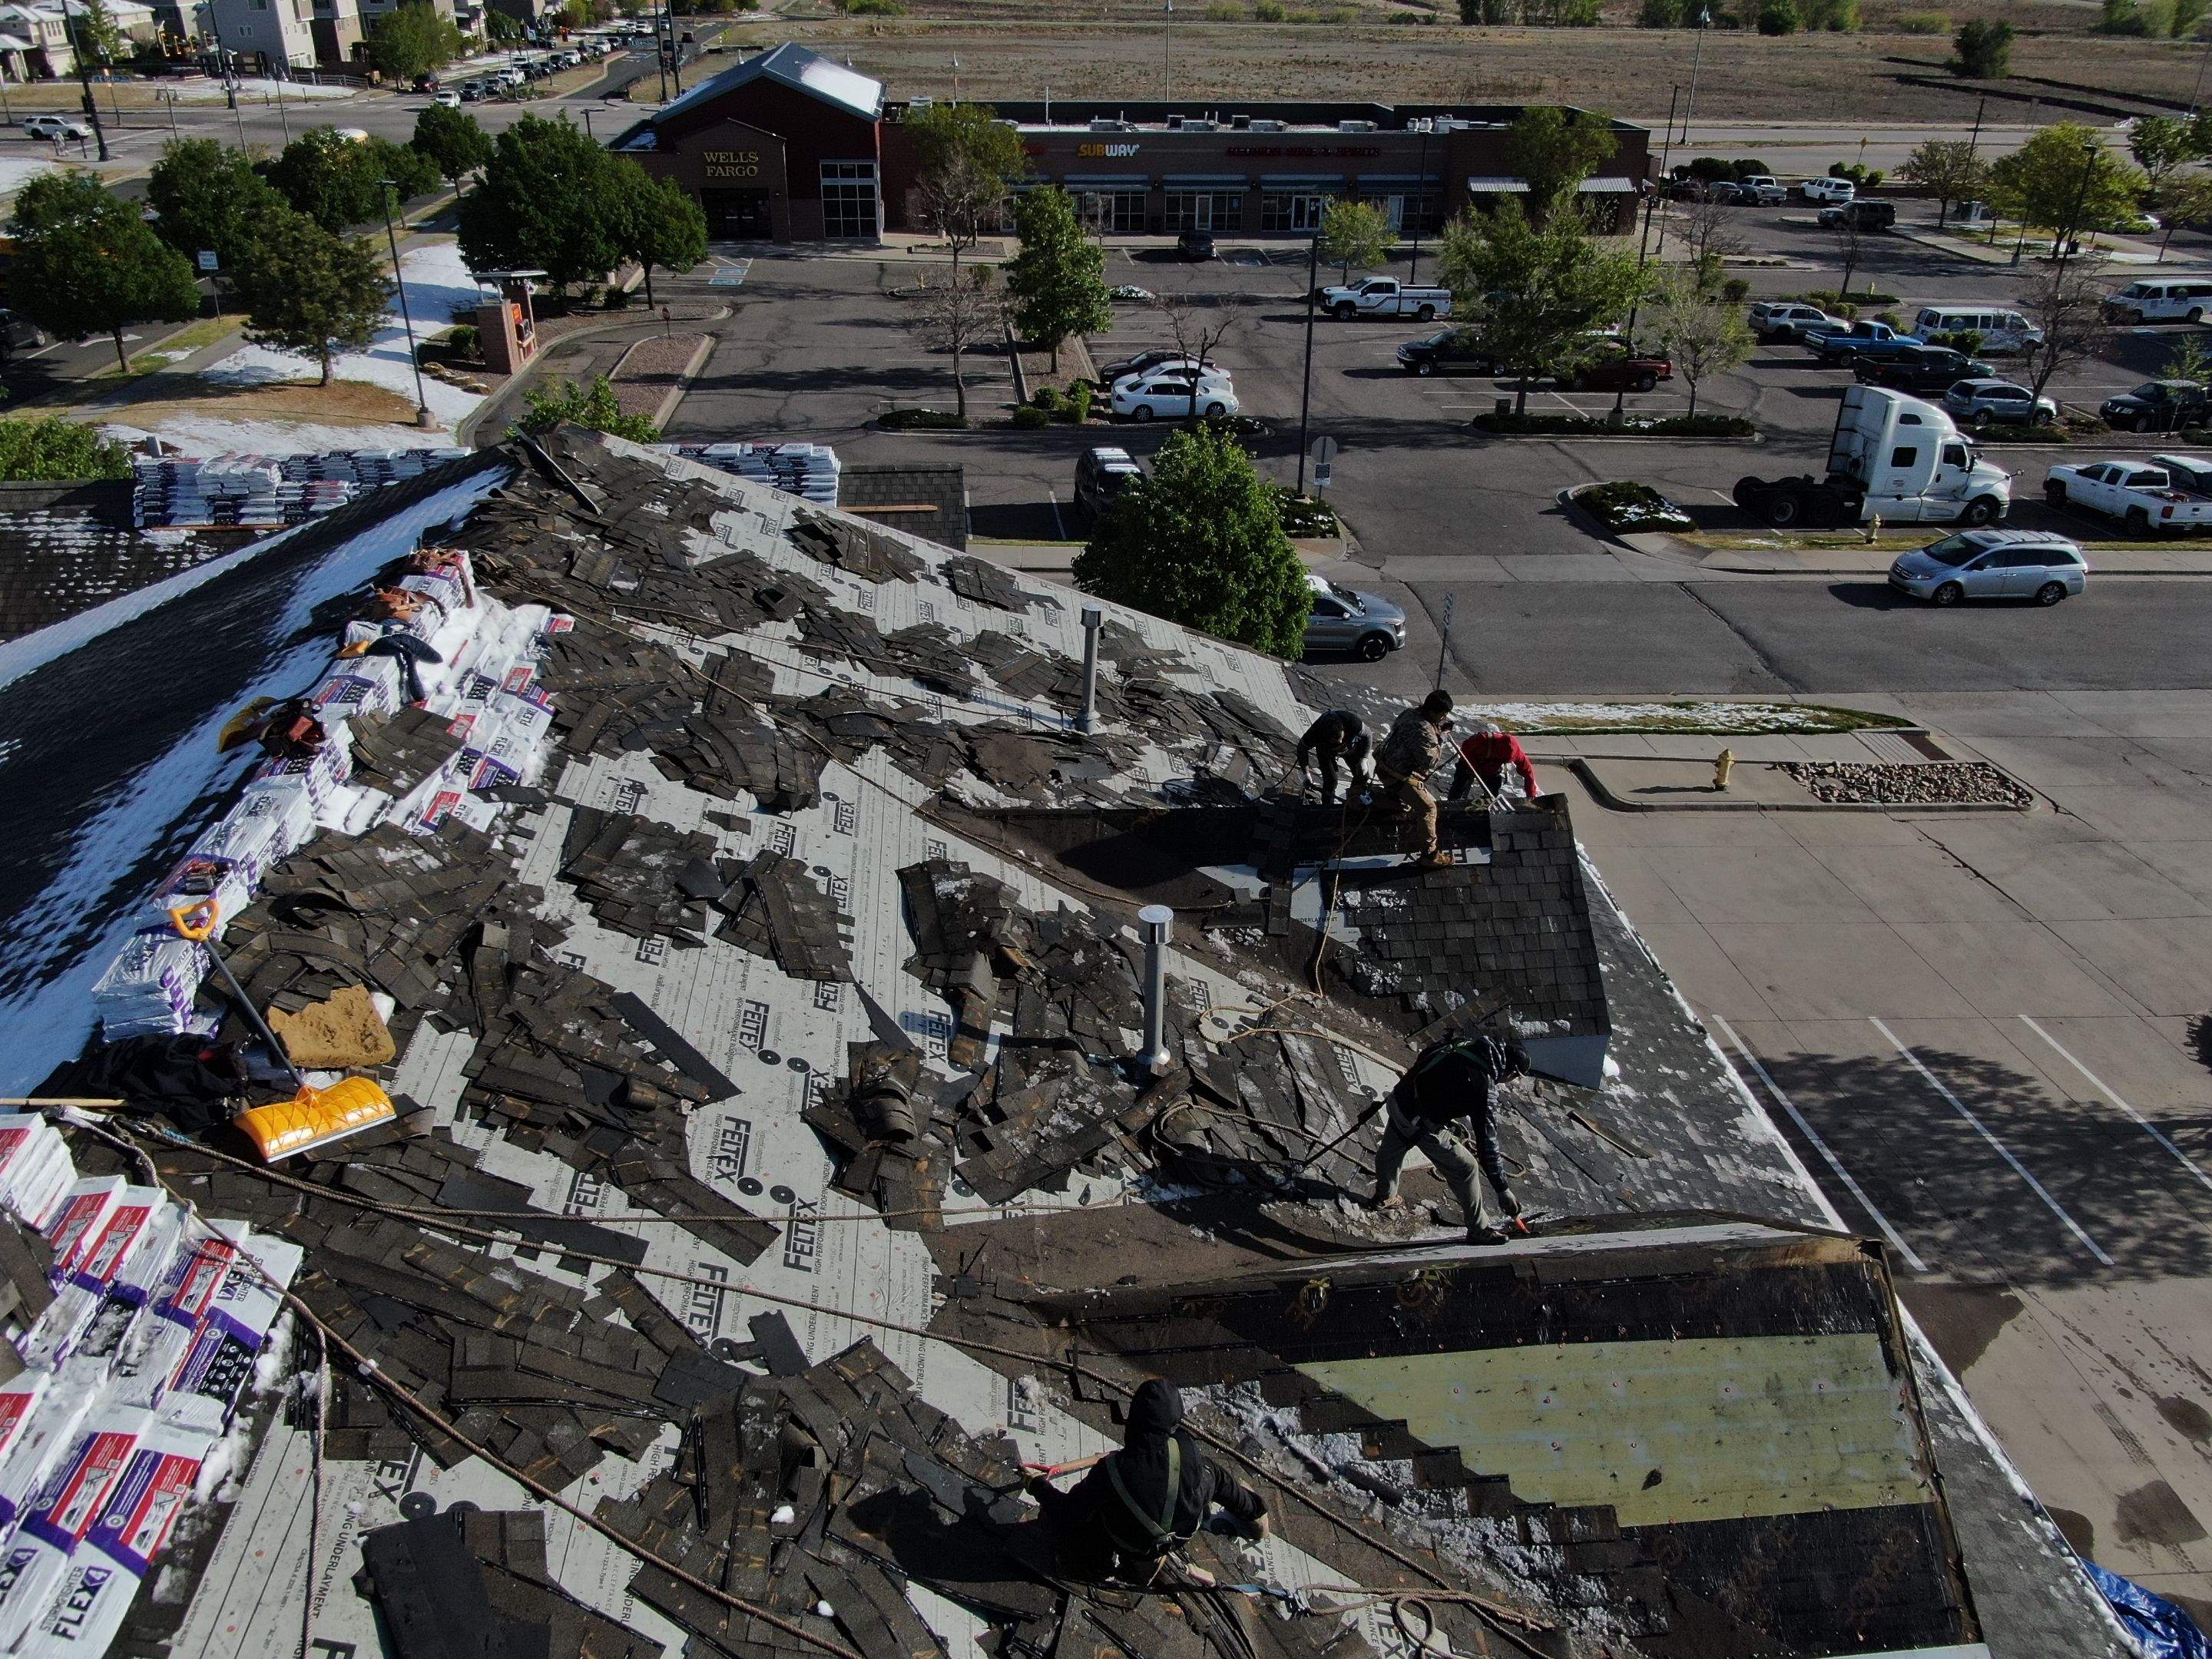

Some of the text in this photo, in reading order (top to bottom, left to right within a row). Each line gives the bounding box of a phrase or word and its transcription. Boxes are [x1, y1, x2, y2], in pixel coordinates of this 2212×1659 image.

[704, 151, 759, 163] WELLS
[1078, 144, 1141, 157] SUBWAY
[706, 165, 759, 177] FARGO
[665, 459, 684, 478] FELTEX
[729, 488, 746, 507] FELT
[771, 489, 787, 502] FEL
[760, 518, 779, 538] FELTEX
[820, 563, 833, 579] LTEX
[857, 589, 874, 612] FELTEX
[919, 600, 935, 624] FELTEX
[1009, 616, 1024, 634] FELTE
[1045, 608, 1058, 628] FELTE
[1197, 662, 1214, 682] FELTEX
[1227, 654, 1242, 673] FELTEX
[833, 799, 856, 837] FELTEX
[773, 821, 797, 859] FELTE
[928, 838, 948, 859] FEL
[830, 874, 849, 911] ELTEX
[635, 937, 666, 967] FELT
[813, 981, 839, 1014] FELT
[1189, 977, 1210, 1014] FELTE
[739, 999, 770, 1055] FELTEX
[928, 1009, 952, 1063] FELTEX
[830, 1057, 840, 1078] OOFING
[482, 1128, 496, 1148] OFING
[706, 1113, 724, 1171] HIGH PERFORMNCE
[714, 1116, 752, 1184] FELTEX
[564, 1171, 602, 1217] FELT
[594, 1182, 611, 1227] HGH PERFOR
[820, 1184, 829, 1210] ROOFING
[815, 1210, 826, 1257] PERFORMAE
[813, 1258, 822, 1275] HIGH
[676, 1259, 697, 1323] HIGH ERFORMAN
[919, 1272, 928, 1320] PERFORMANCE
[805, 1283, 820, 1365] OFING UNDERLMENT
[916, 1353, 926, 1398] UNDERLAYM
[648, 1442, 662, 1467] HIGH
[313, 1531, 349, 1620] UNDERLAYMENT
[39, 1566, 84, 1632] STORMFIGHTER
